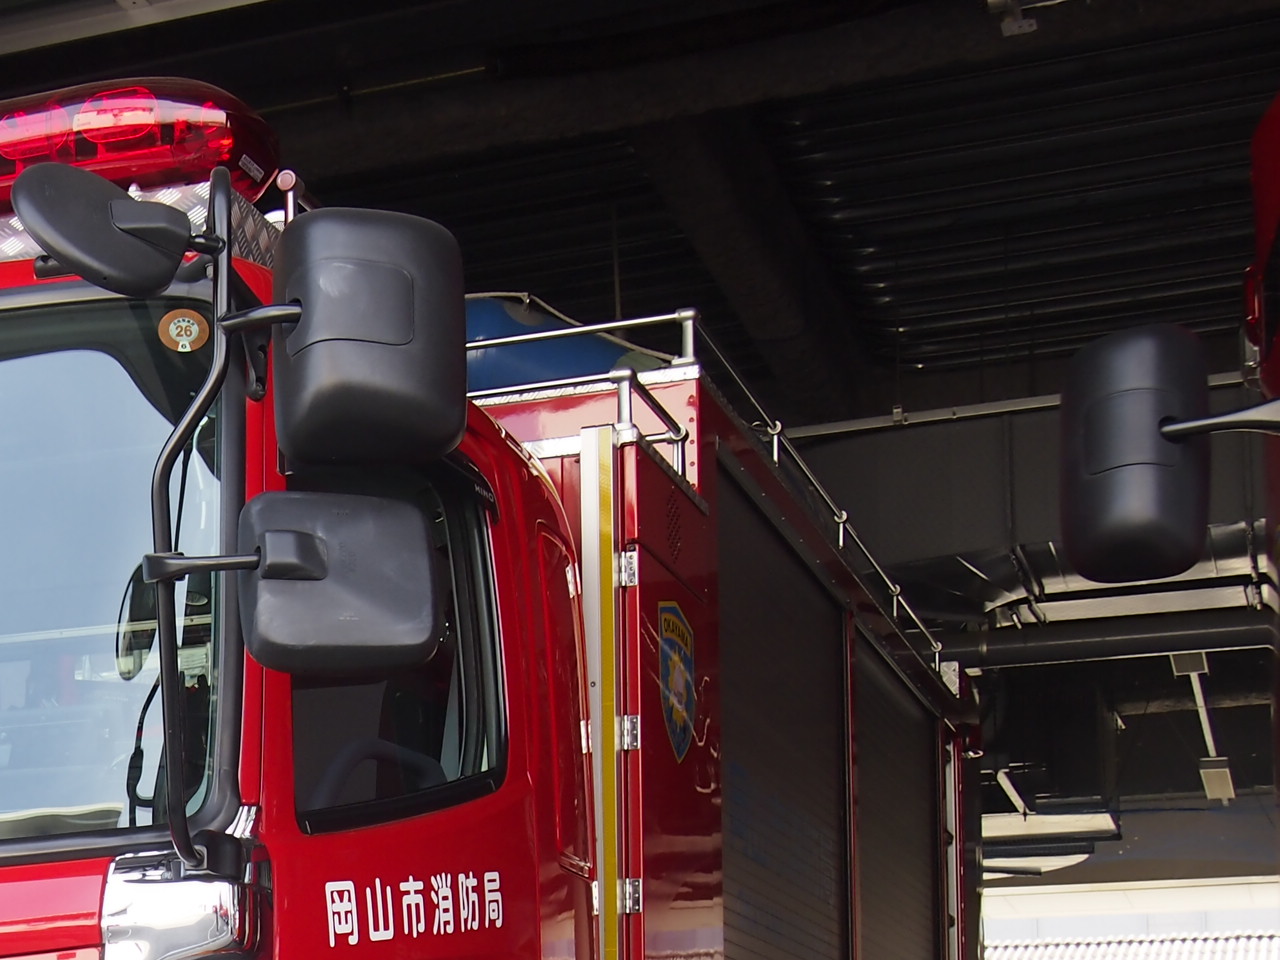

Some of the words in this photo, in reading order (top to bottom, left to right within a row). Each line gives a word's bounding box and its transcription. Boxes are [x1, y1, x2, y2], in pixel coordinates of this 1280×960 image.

[175, 325, 193, 337] 26
[475, 484, 494, 502] HINO
[664, 617, 689, 647] OKAYAMA
[325, 871, 502, 948] 岡山市消防局
